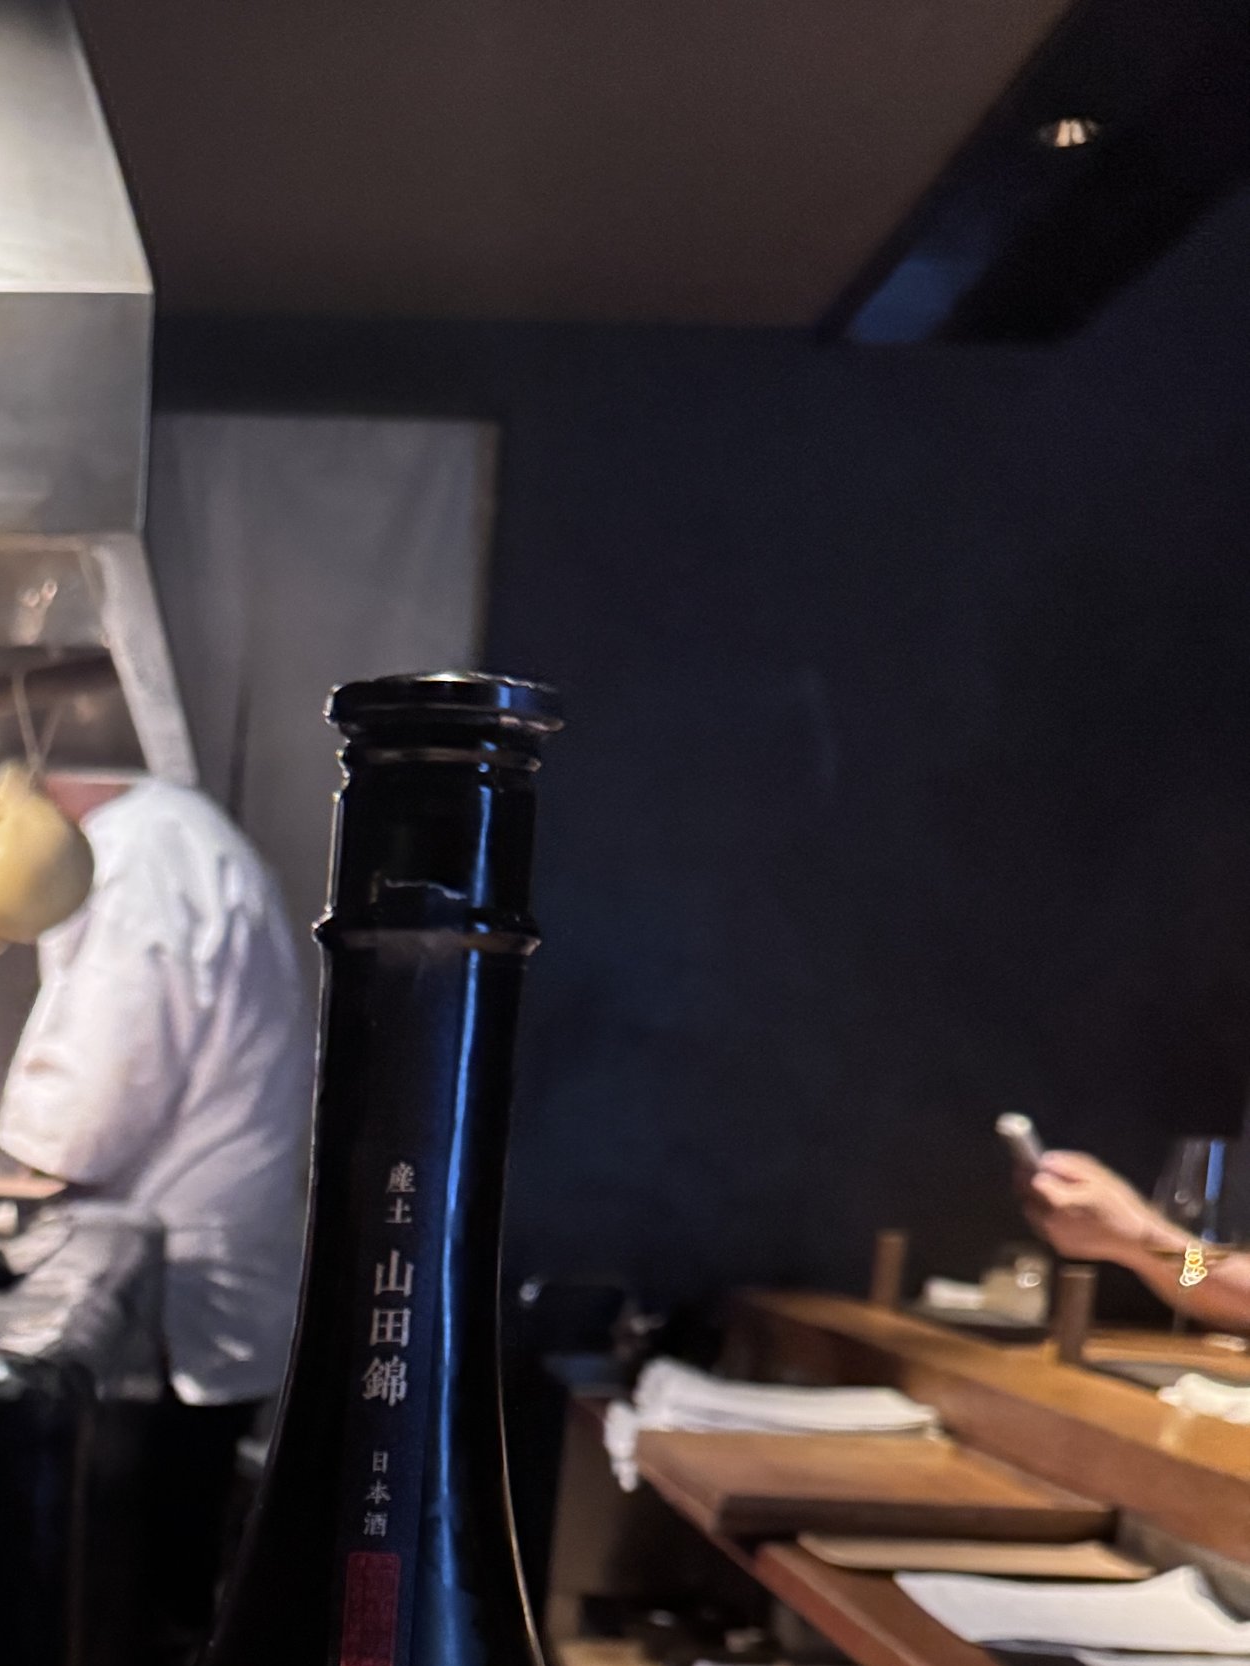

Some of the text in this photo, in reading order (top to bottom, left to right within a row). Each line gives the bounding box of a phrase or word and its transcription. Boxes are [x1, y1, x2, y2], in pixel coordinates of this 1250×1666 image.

[385, 1160, 417, 1225] 産土
[360, 1249, 415, 1408] 山田錦
[362, 1449, 393, 1538] 日本酒
